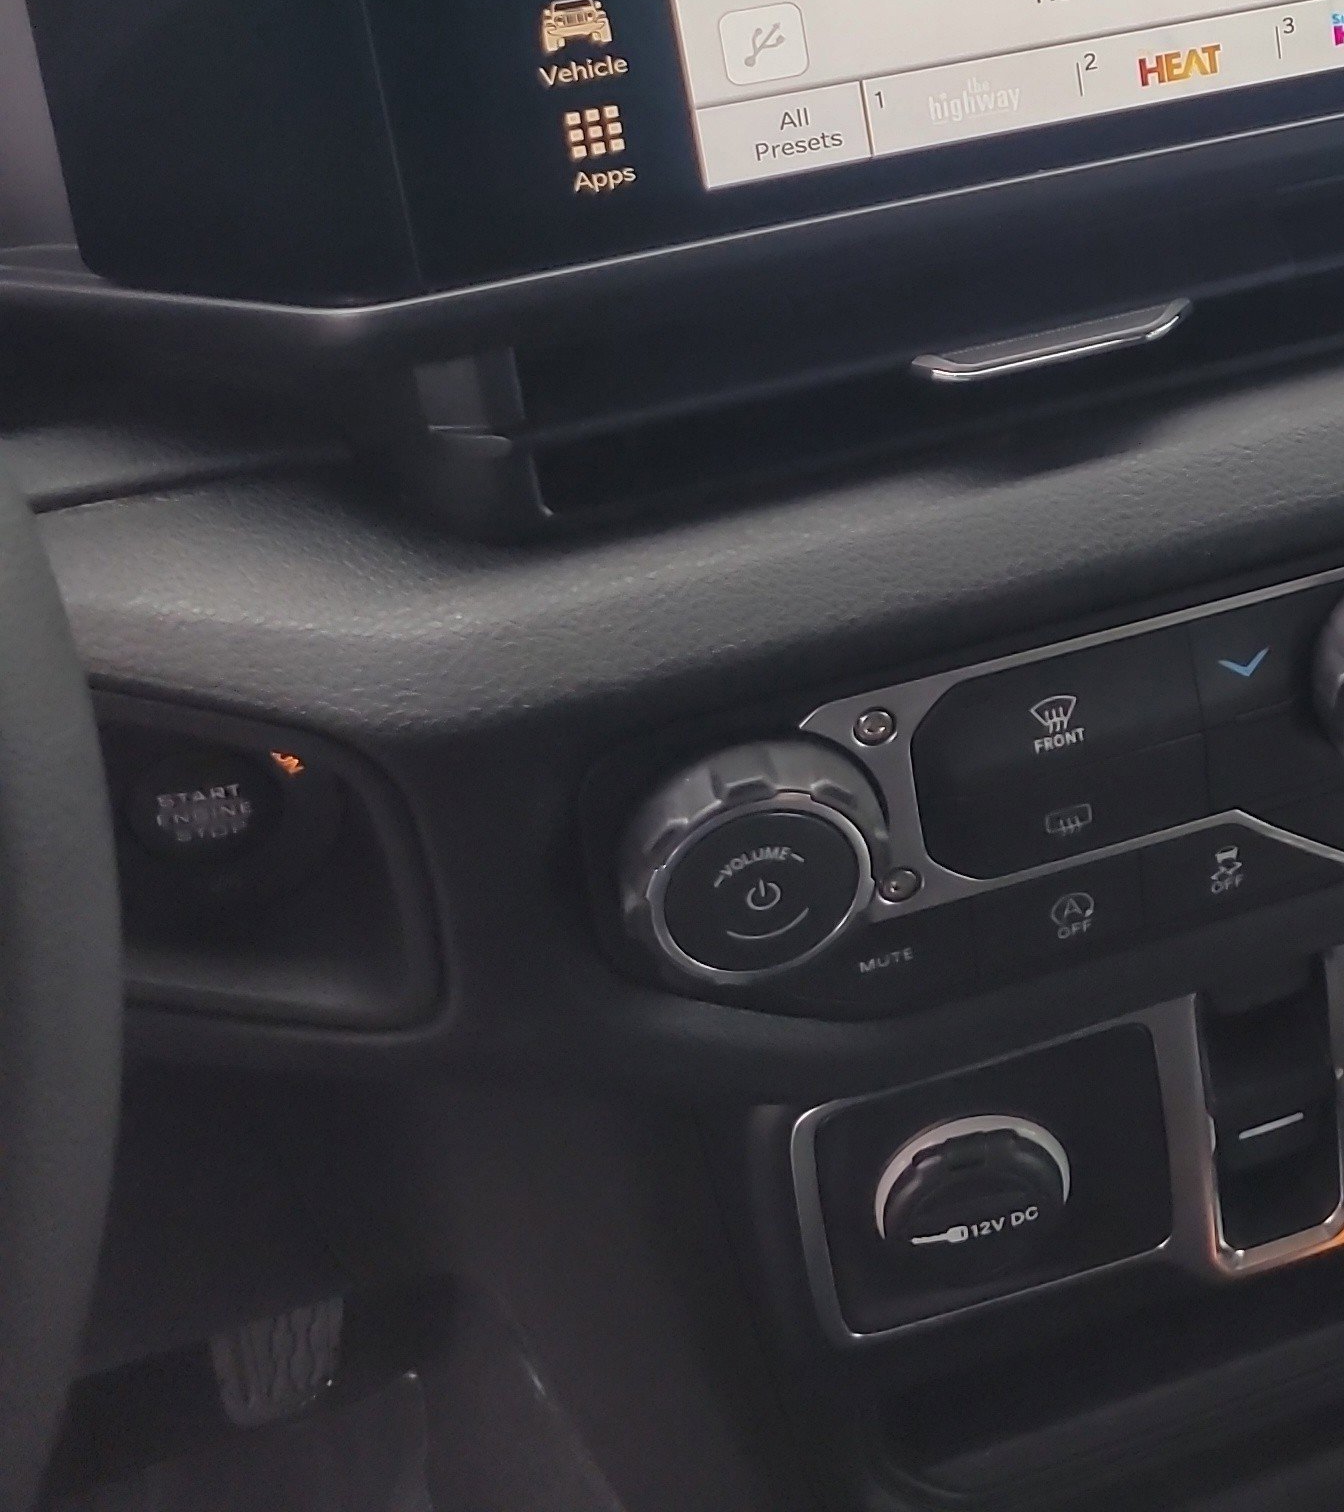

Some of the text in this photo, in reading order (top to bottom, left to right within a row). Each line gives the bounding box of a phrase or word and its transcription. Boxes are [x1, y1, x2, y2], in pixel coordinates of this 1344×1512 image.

[1283, 17, 1296, 34] 3
[538, 55, 629, 86] Vehicle
[1083, 52, 1099, 71] 2
[1137, 43, 1221, 87] HEAT
[874, 90, 886, 109] 1
[928, 88, 1020, 121] highway
[780, 107, 810, 131] All
[755, 131, 843, 162] Presets
[574, 167, 636, 193] Apps
[1034, 727, 1085, 754] FRONT
[720, 846, 791, 879] VOLUME
[1057, 920, 1092, 939] OFF
[859, 947, 913, 973] MUTE
[971, 1206, 1039, 1237] 12V DC
